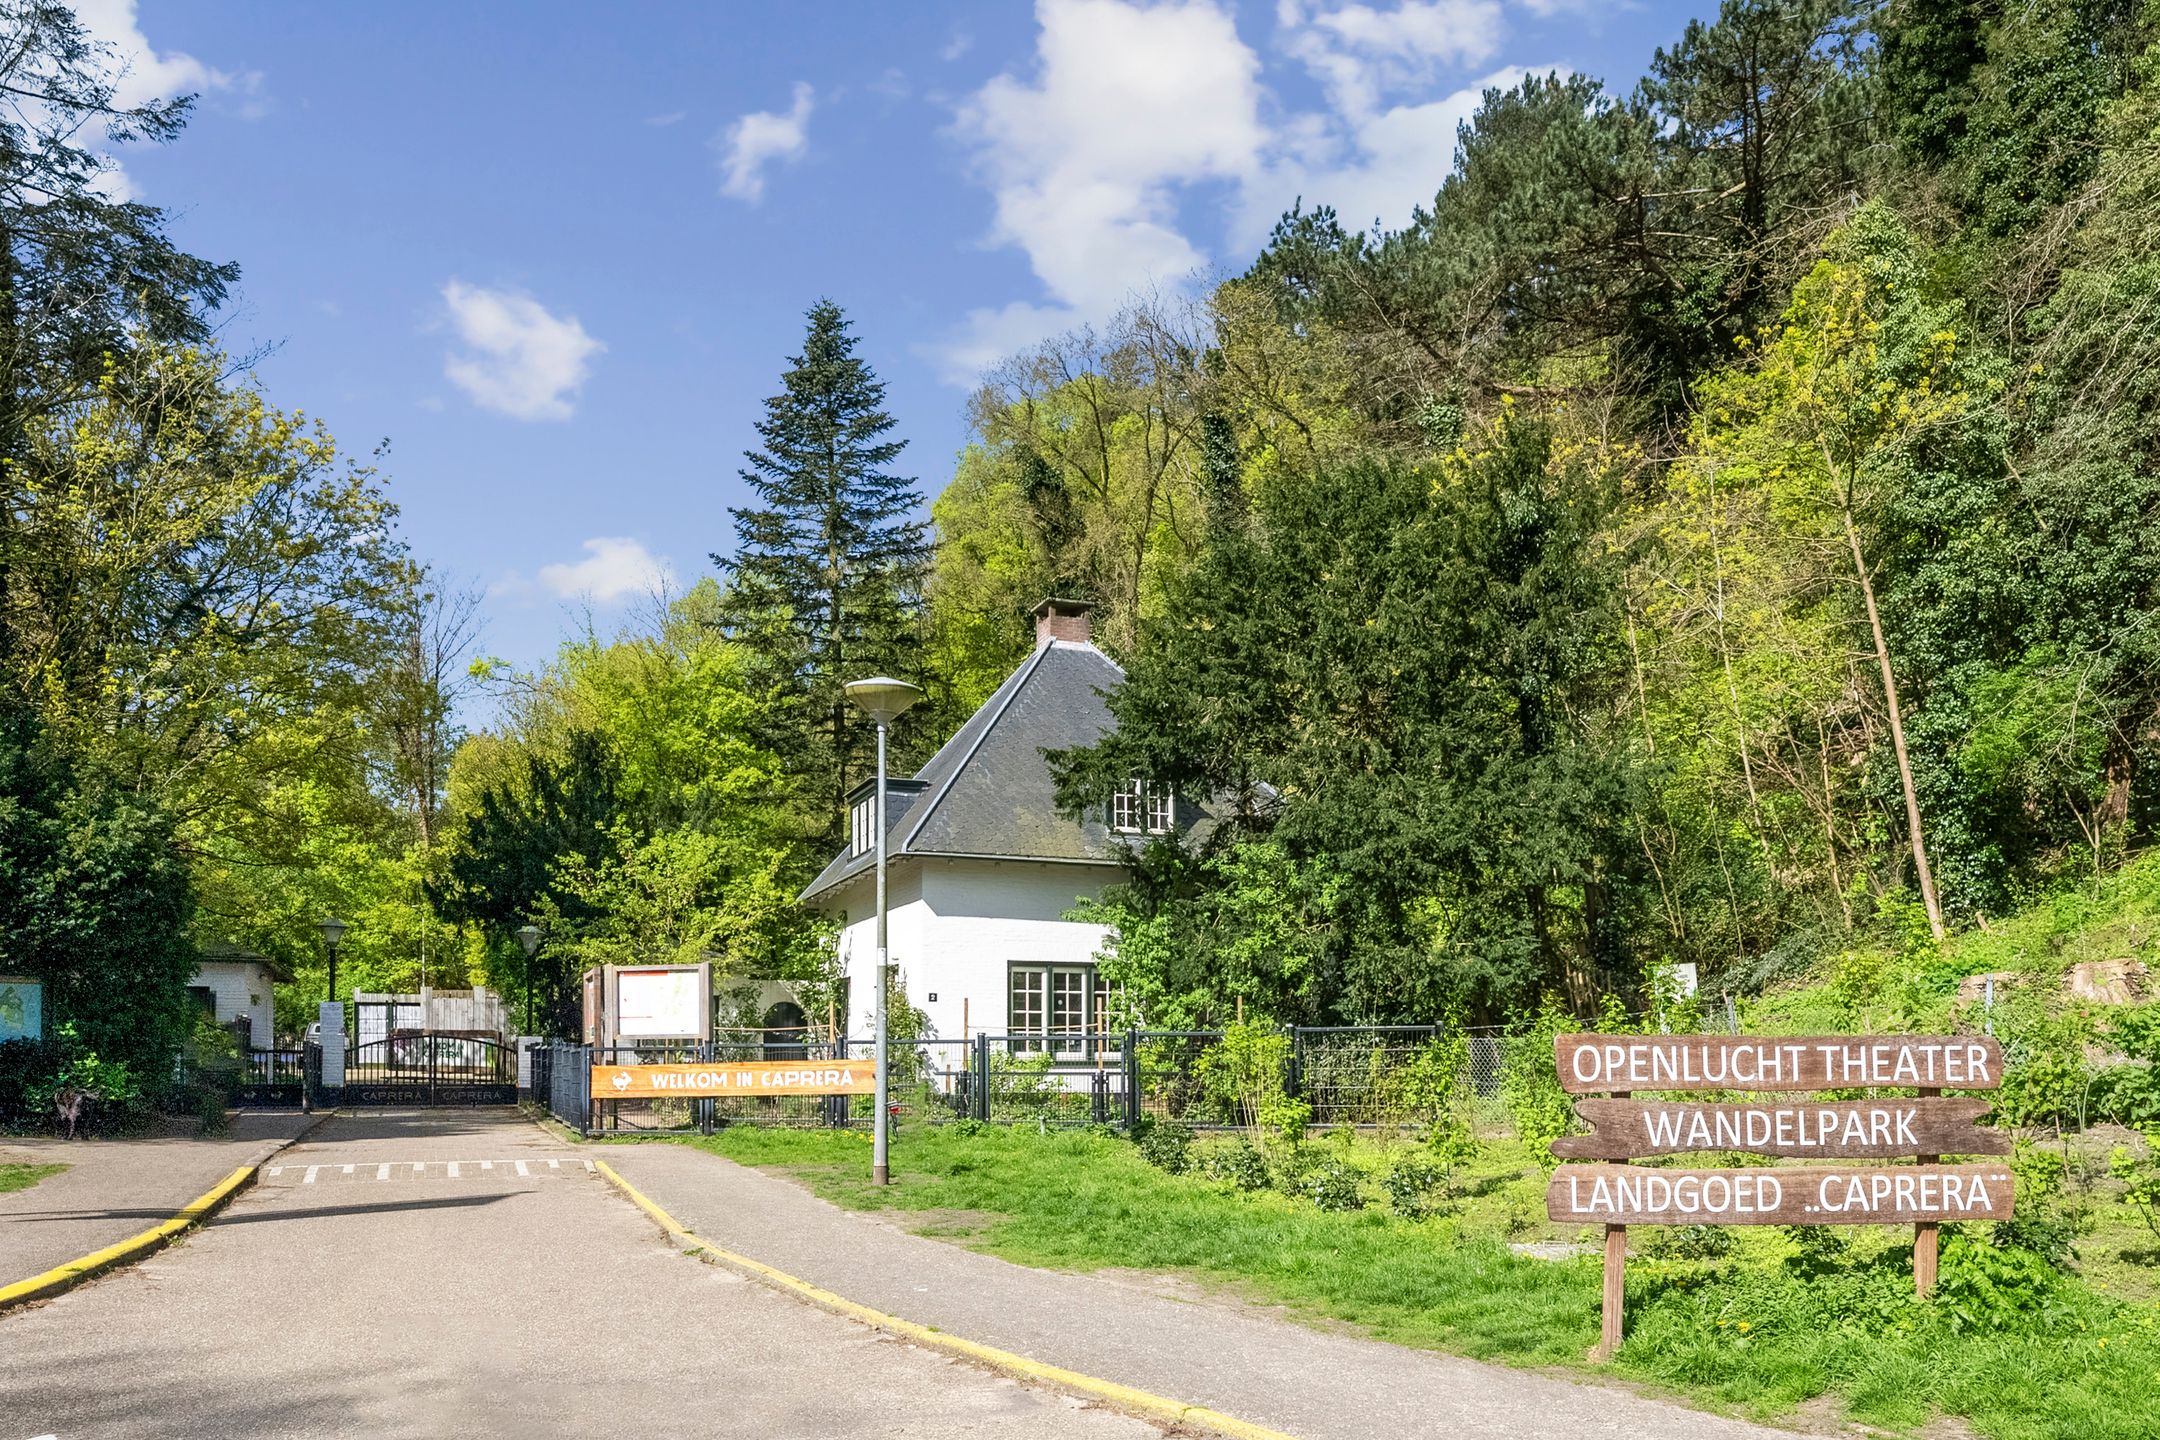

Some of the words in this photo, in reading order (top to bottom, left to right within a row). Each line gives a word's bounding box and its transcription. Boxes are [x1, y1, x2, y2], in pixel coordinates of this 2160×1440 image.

[1572, 1045, 1806, 1082] OPENLUCHT
[1818, 1045, 1990, 1082] THEATER
[652, 1072, 727, 1088] WELKOM
[737, 1072, 752, 1087] IN
[761, 1070, 853, 1087] CAPRERA
[362, 1091, 423, 1101] CAPRERA
[443, 1091, 501, 1101] CAPRERA
[1645, 1109, 1918, 1147] WANDELPARK
[1571, 1175, 1782, 1213] LANDGOED
